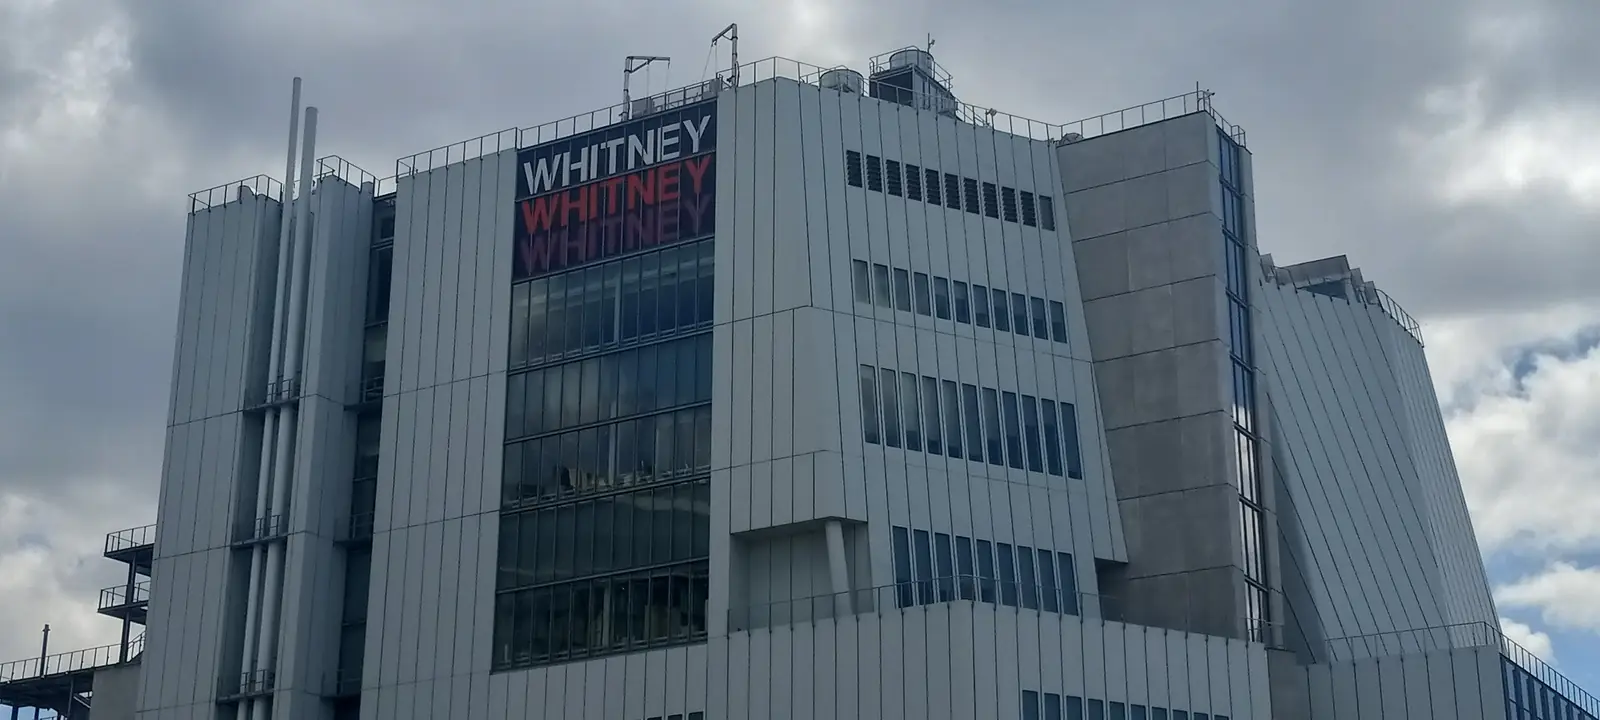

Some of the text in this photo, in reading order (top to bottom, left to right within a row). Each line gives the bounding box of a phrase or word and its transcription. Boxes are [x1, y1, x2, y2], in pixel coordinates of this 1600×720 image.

[522, 155, 712, 235] WHITNEY
[523, 115, 711, 195] WHITNEY
[520, 194, 710, 275] WHITNEY
